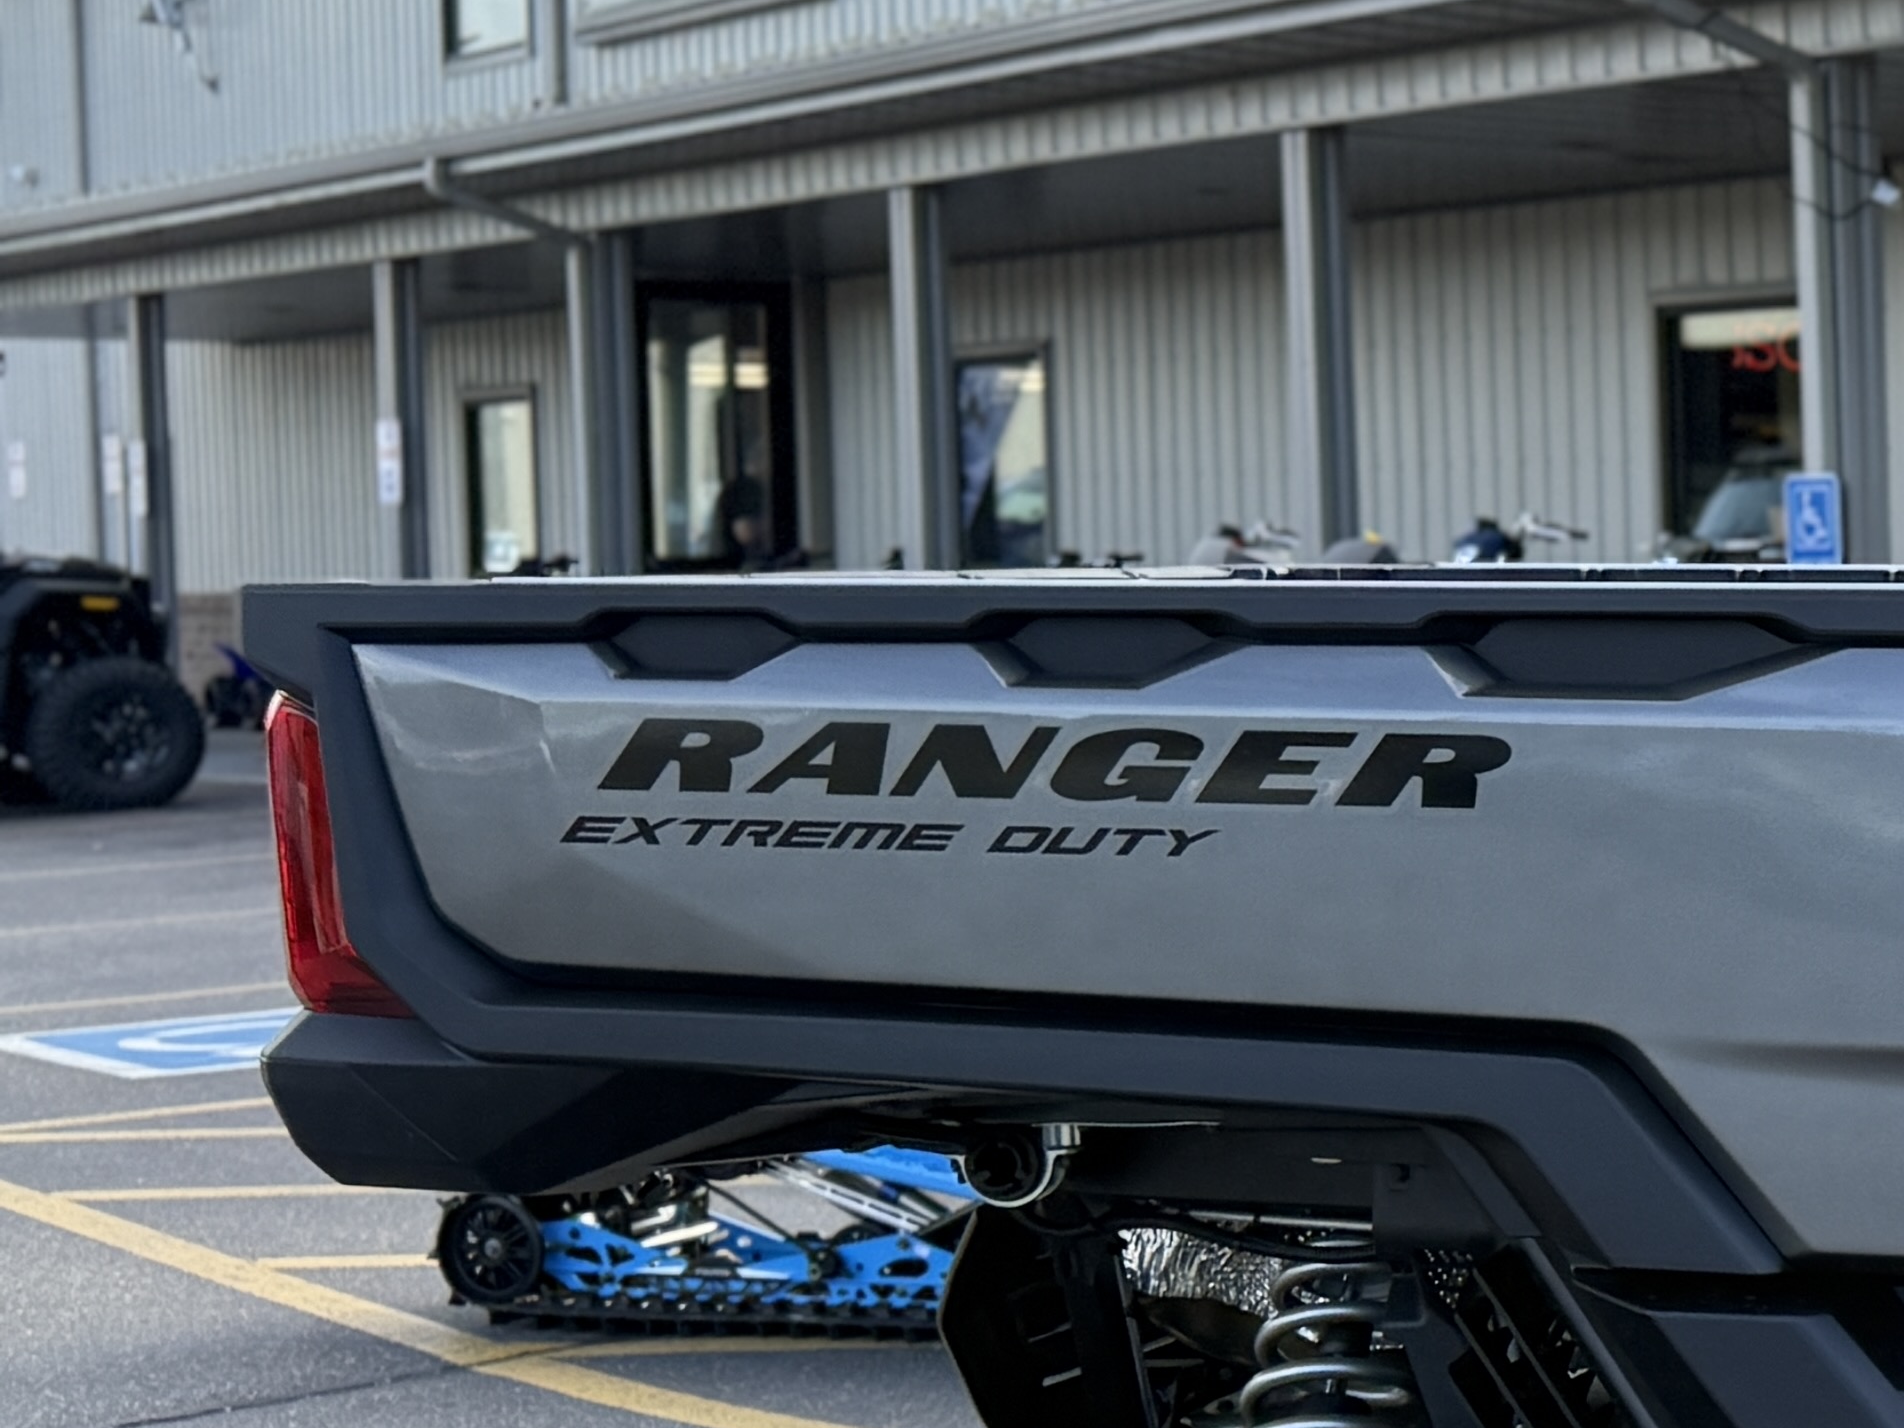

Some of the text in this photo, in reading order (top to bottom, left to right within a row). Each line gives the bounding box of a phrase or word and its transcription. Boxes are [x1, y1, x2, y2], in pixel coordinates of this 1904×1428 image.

[597, 717, 1514, 809] RANGER
[559, 814, 1219, 858] EXTREME DUTY
